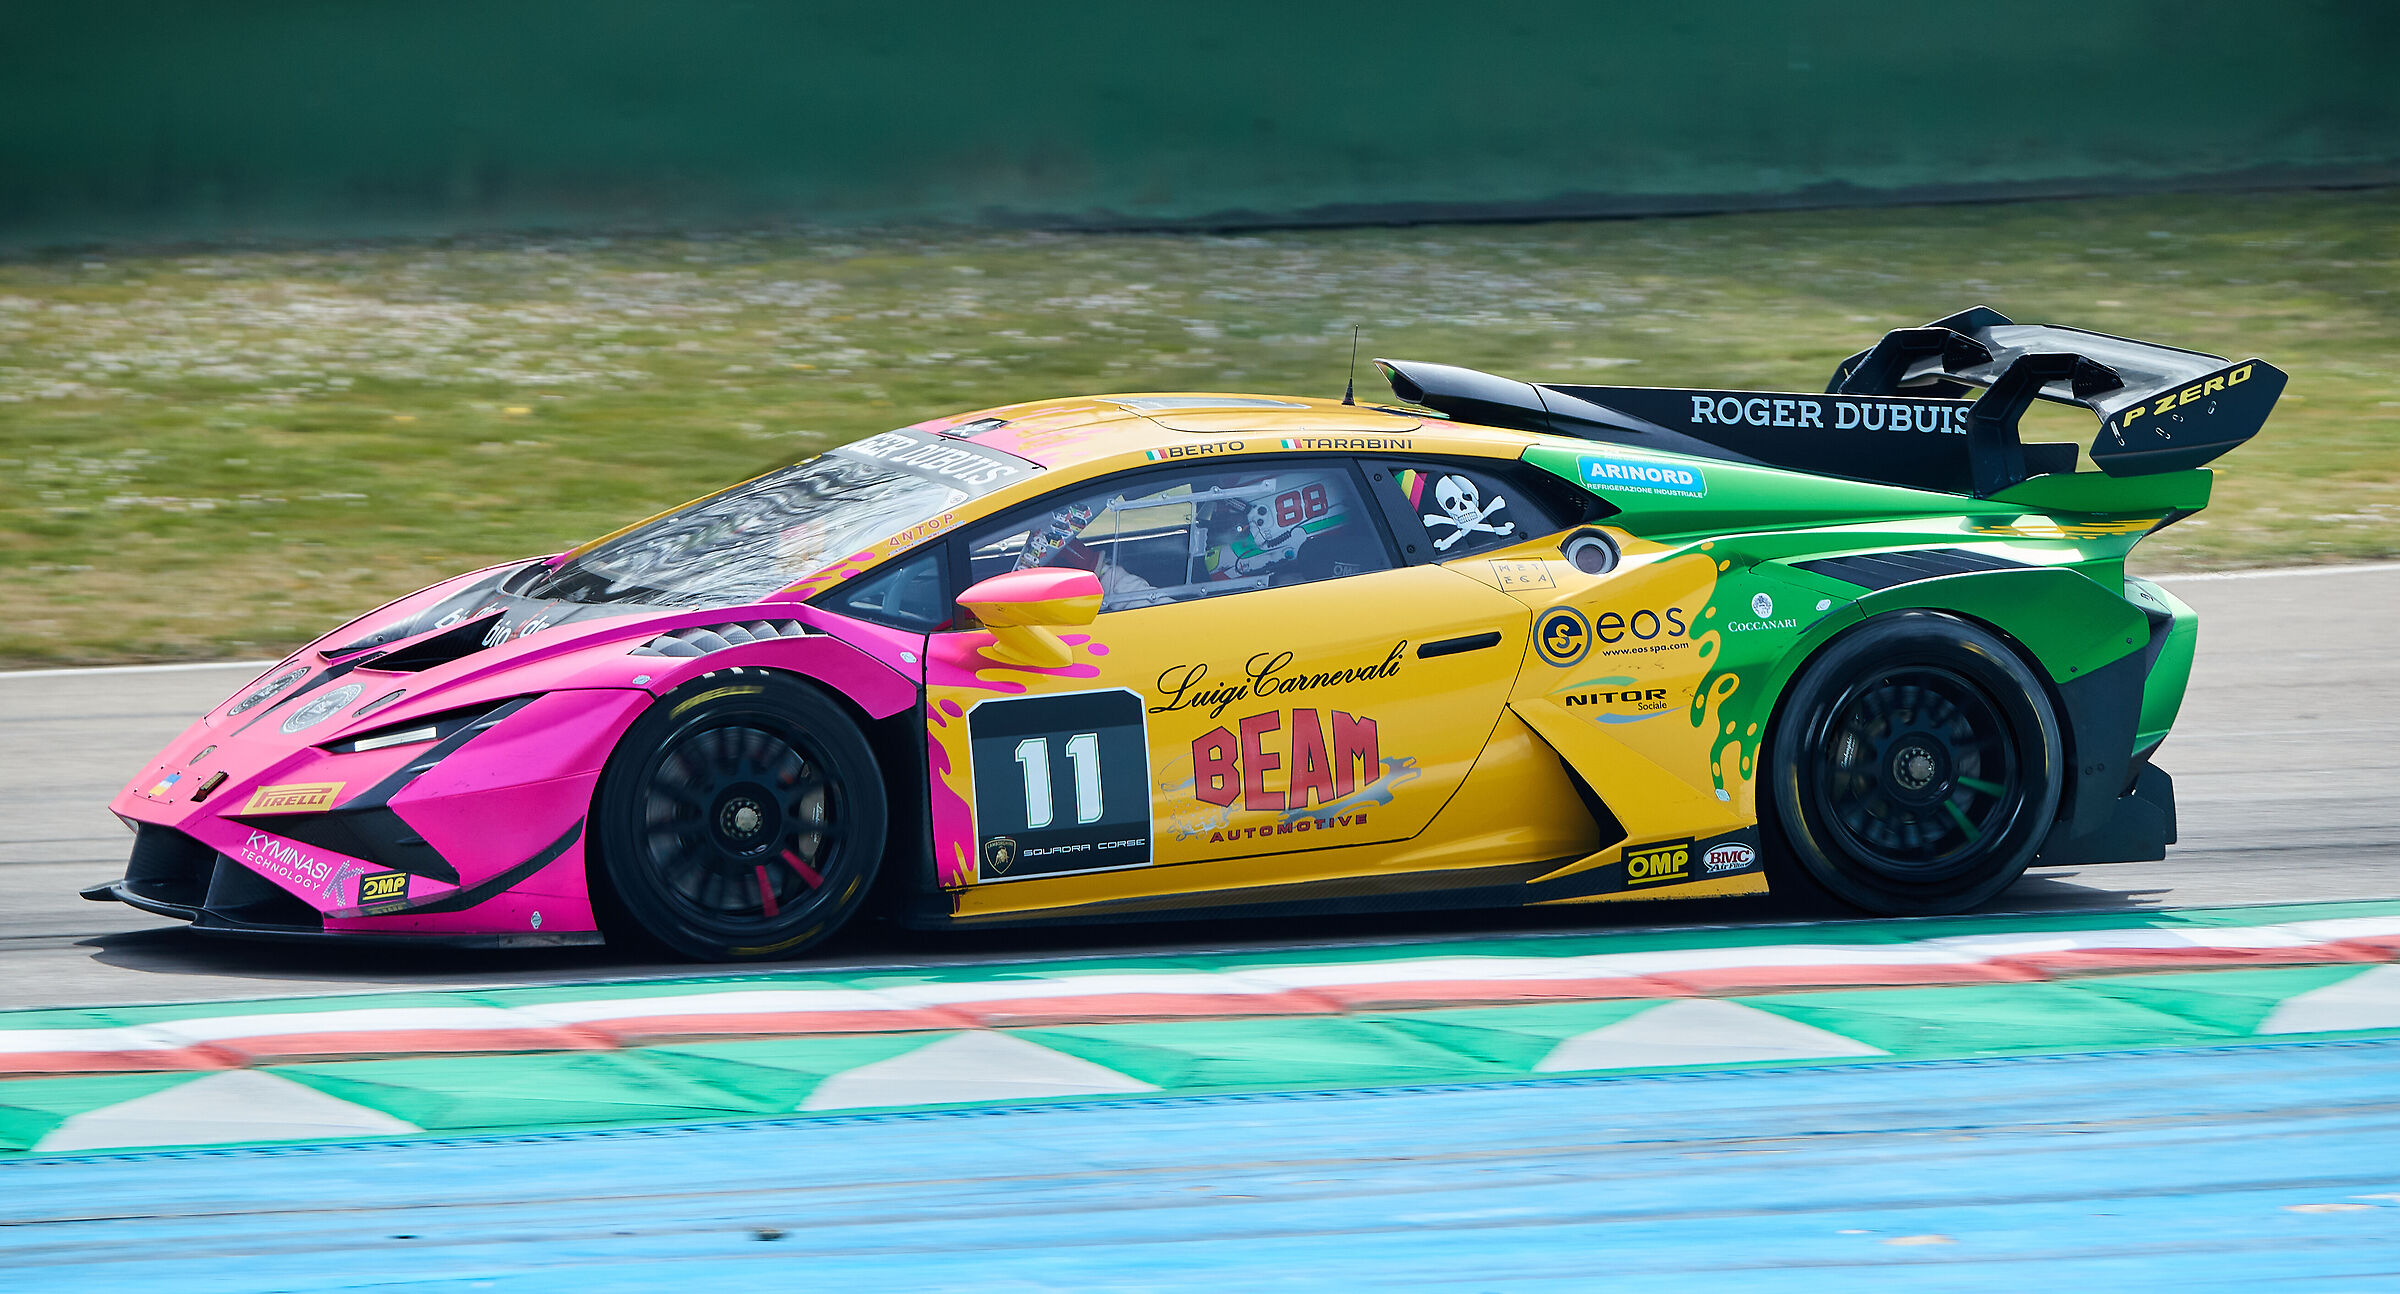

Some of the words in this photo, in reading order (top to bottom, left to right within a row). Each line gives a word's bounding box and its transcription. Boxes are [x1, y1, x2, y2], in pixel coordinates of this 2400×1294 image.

[2123, 406, 2146, 428] P
[2153, 364, 2253, 416] ZERO
[1690, 395, 1824, 428] ROGER
[1168, 440, 1245, 458] BERTO
[1302, 438, 1413, 450] TARABINI
[889, 444, 1019, 486] DUBUIS
[1591, 462, 1694, 485] ARINORD
[1586, 482, 1653, 494] REFRIGERAZIONE
[1653, 488, 1704, 499] INDUSTRIALE
[1275, 483, 1329, 528] 88
[1596, 607, 1686, 643] eos
[1727, 618, 1797, 633] COCCANARI
[1148, 663, 1252, 719] Luigi
[1245, 639, 1408, 697] Carnevali
[1565, 688, 1667, 707] NITOR
[1637, 702, 1668, 711] Sociale
[1191, 708, 1380, 812] BEAM
[1014, 732, 1104, 829] 11
[252, 787, 333, 808] PIRELLI
[1209, 813, 1368, 844] AUTOMOTIVE
[246, 830, 333, 882] KYMINASI
[1023, 843, 1091, 857] SQUADRA
[1097, 838, 1146, 850] CORSE
[1709, 849, 1750, 864] BMC
[240, 848, 321, 892] TECHNOLOGY
[1627, 850, 1689, 878] OMP
[363, 876, 406, 896] OMP
